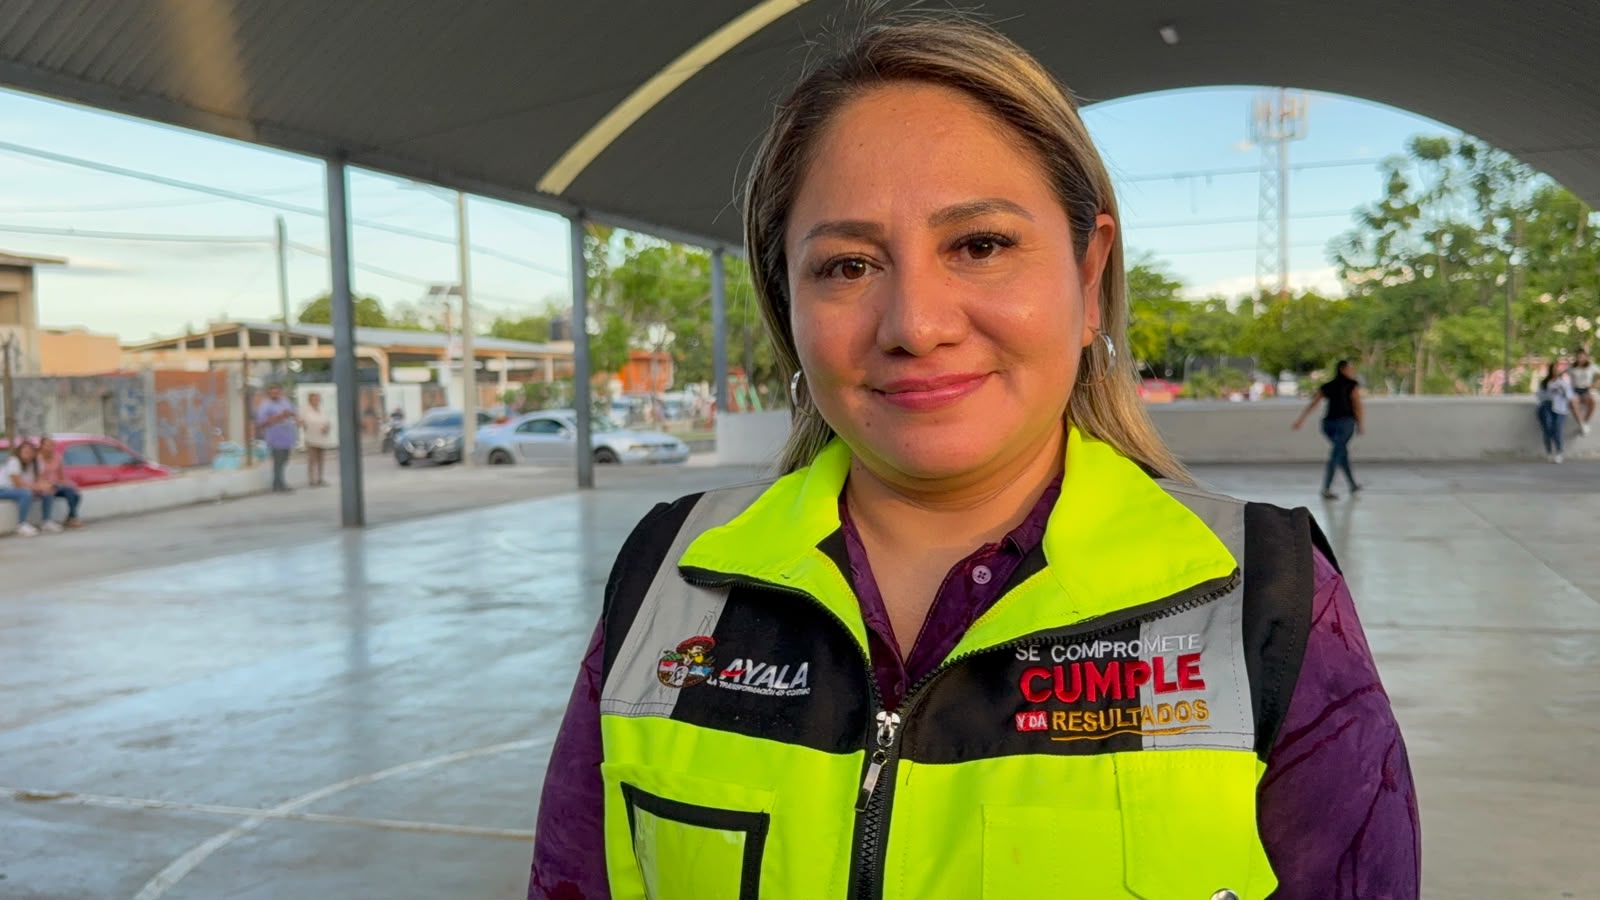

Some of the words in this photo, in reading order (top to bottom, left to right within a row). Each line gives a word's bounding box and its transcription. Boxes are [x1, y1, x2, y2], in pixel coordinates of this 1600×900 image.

[1015, 644, 1041, 661] SE
[1051, 633, 1201, 662] COMPROMETE
[706, 675, 718, 686] LA
[720, 658, 809, 689] AYALA
[1019, 652, 1206, 703] CUMPLE
[1016, 713, 1026, 729] Y
[1029, 712, 1048, 728] DA
[1052, 699, 1210, 732] RESULTADOS
